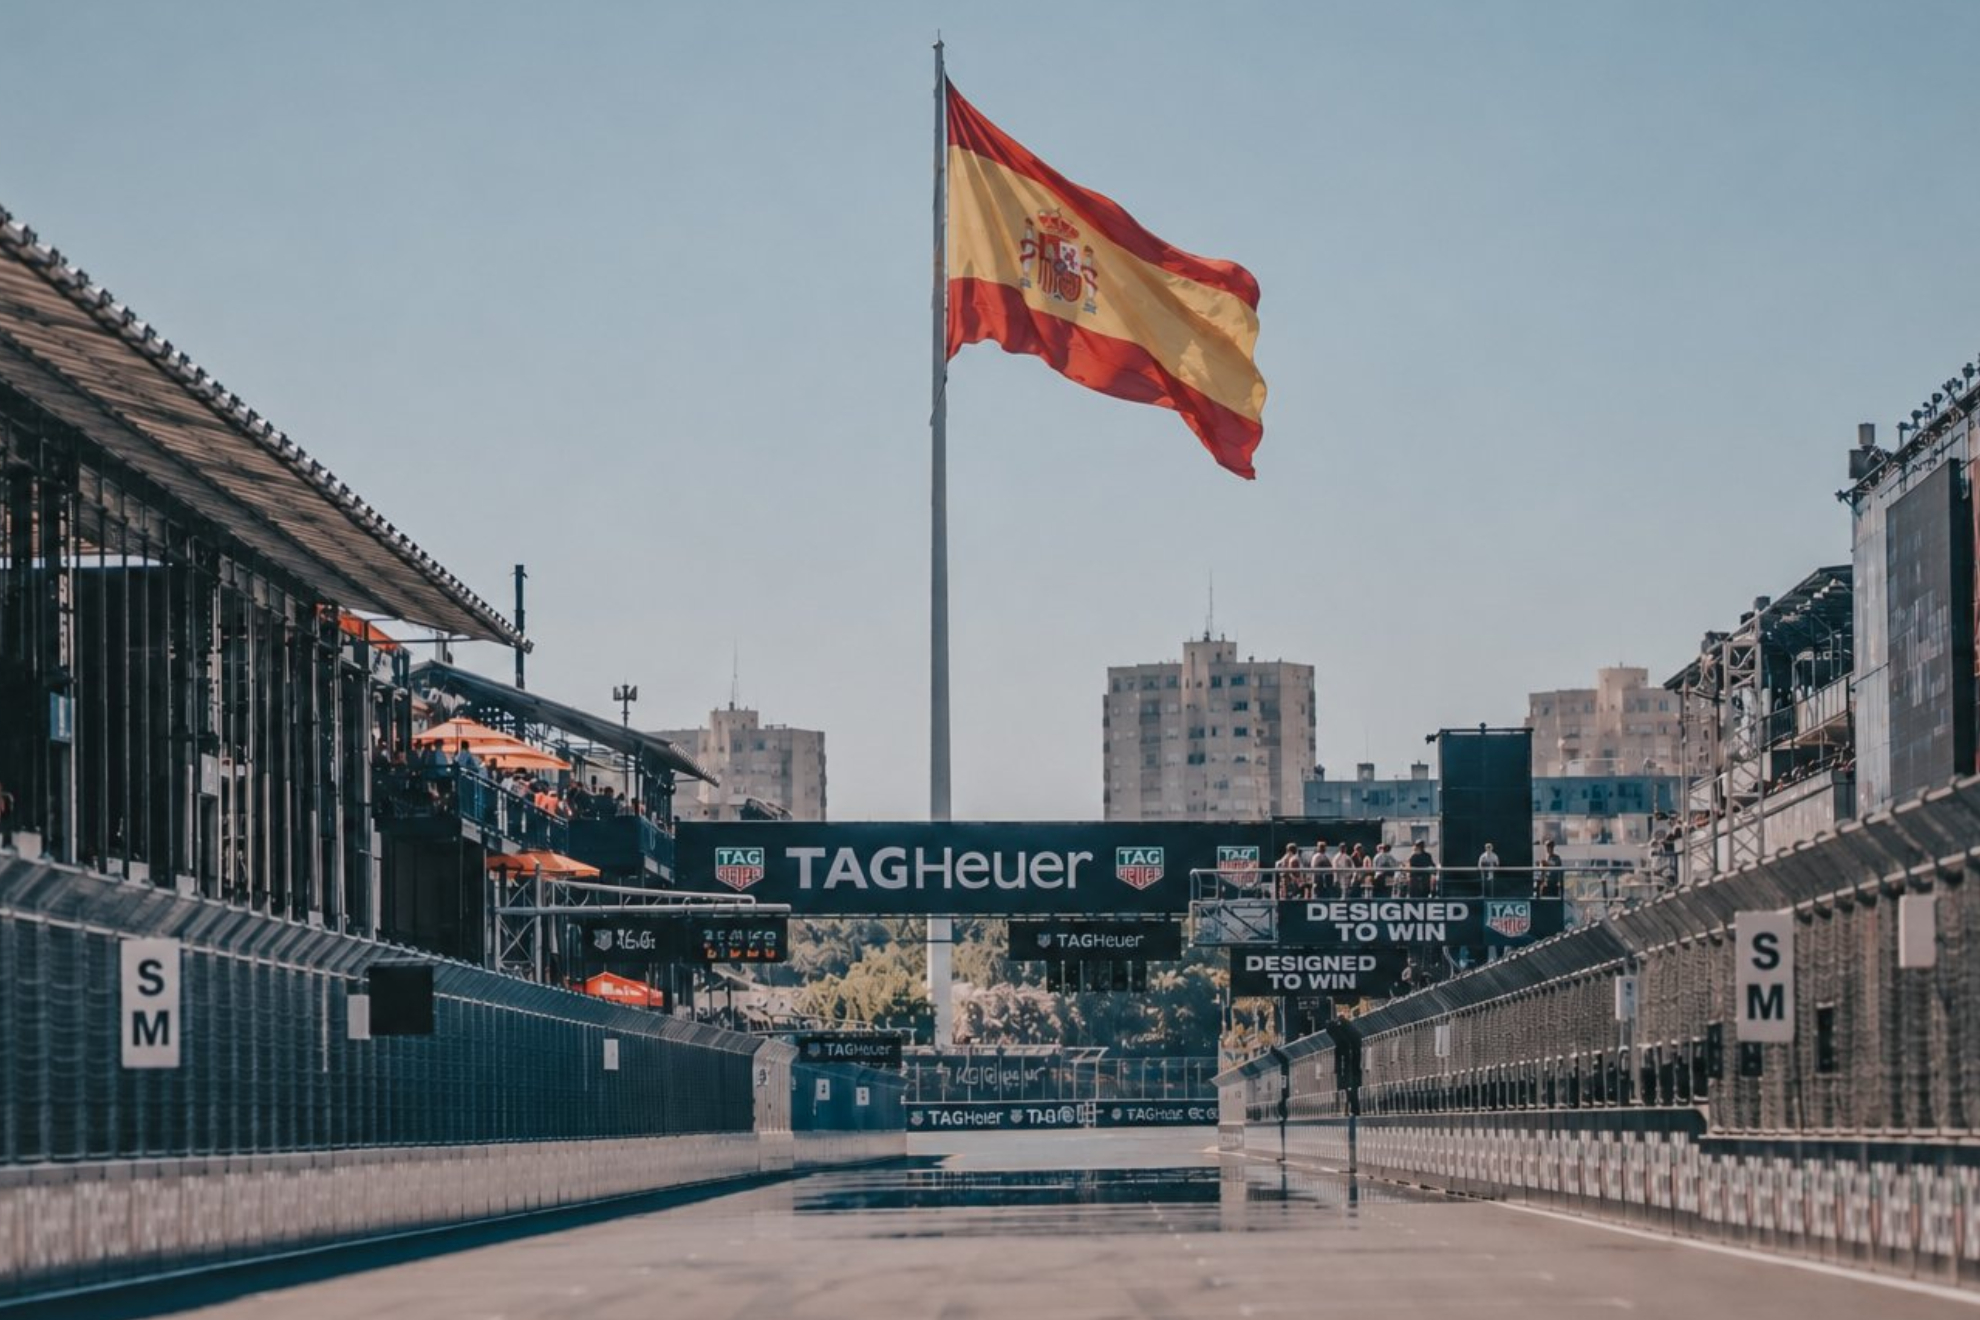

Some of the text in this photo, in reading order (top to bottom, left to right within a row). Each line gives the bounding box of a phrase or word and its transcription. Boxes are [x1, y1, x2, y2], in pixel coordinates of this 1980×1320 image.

[719, 850, 761, 865] TAG
[1120, 850, 1160, 865] TAG
[785, 846, 1094, 889] TAGHeuer
[1306, 902, 1469, 922] DESIGNED
[1492, 904, 1527, 918] TAG
[1335, 923, 1446, 942] TO WIN
[1245, 955, 1377, 972] DESIGNED
[1267, 973, 1356, 990] TO WIN
